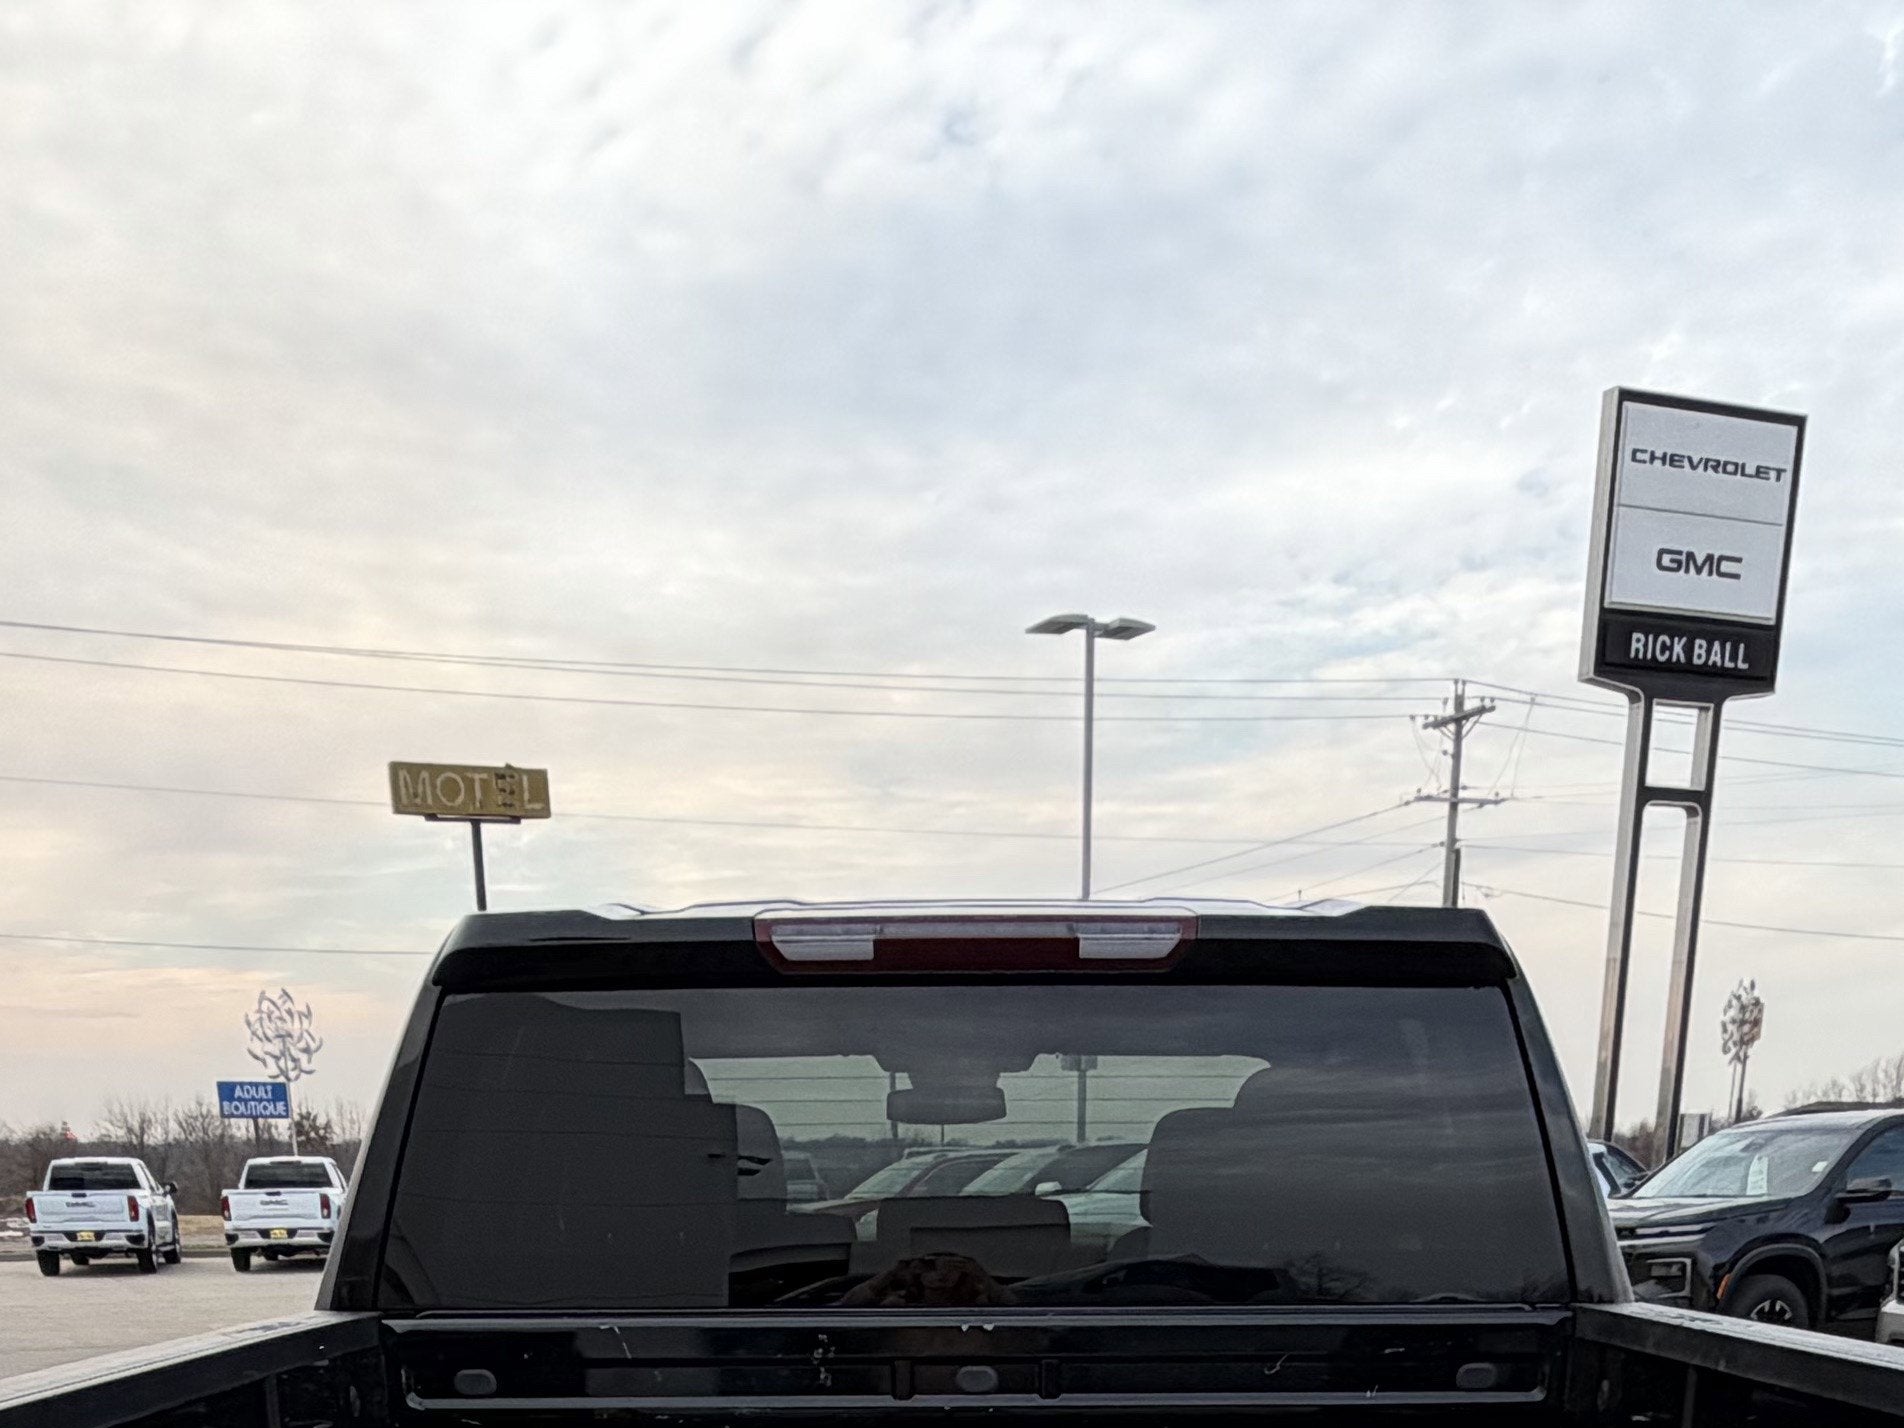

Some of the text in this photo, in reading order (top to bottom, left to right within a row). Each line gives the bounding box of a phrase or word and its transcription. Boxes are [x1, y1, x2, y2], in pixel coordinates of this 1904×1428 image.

[1630, 447, 1787, 483] CHEVROLET
[1655, 547, 1743, 580] GMC
[1629, 631, 1749, 670] RICK BALL
[234, 1084, 272, 1099] ADULT
[222, 1101, 287, 1116] BOUTIQUE
